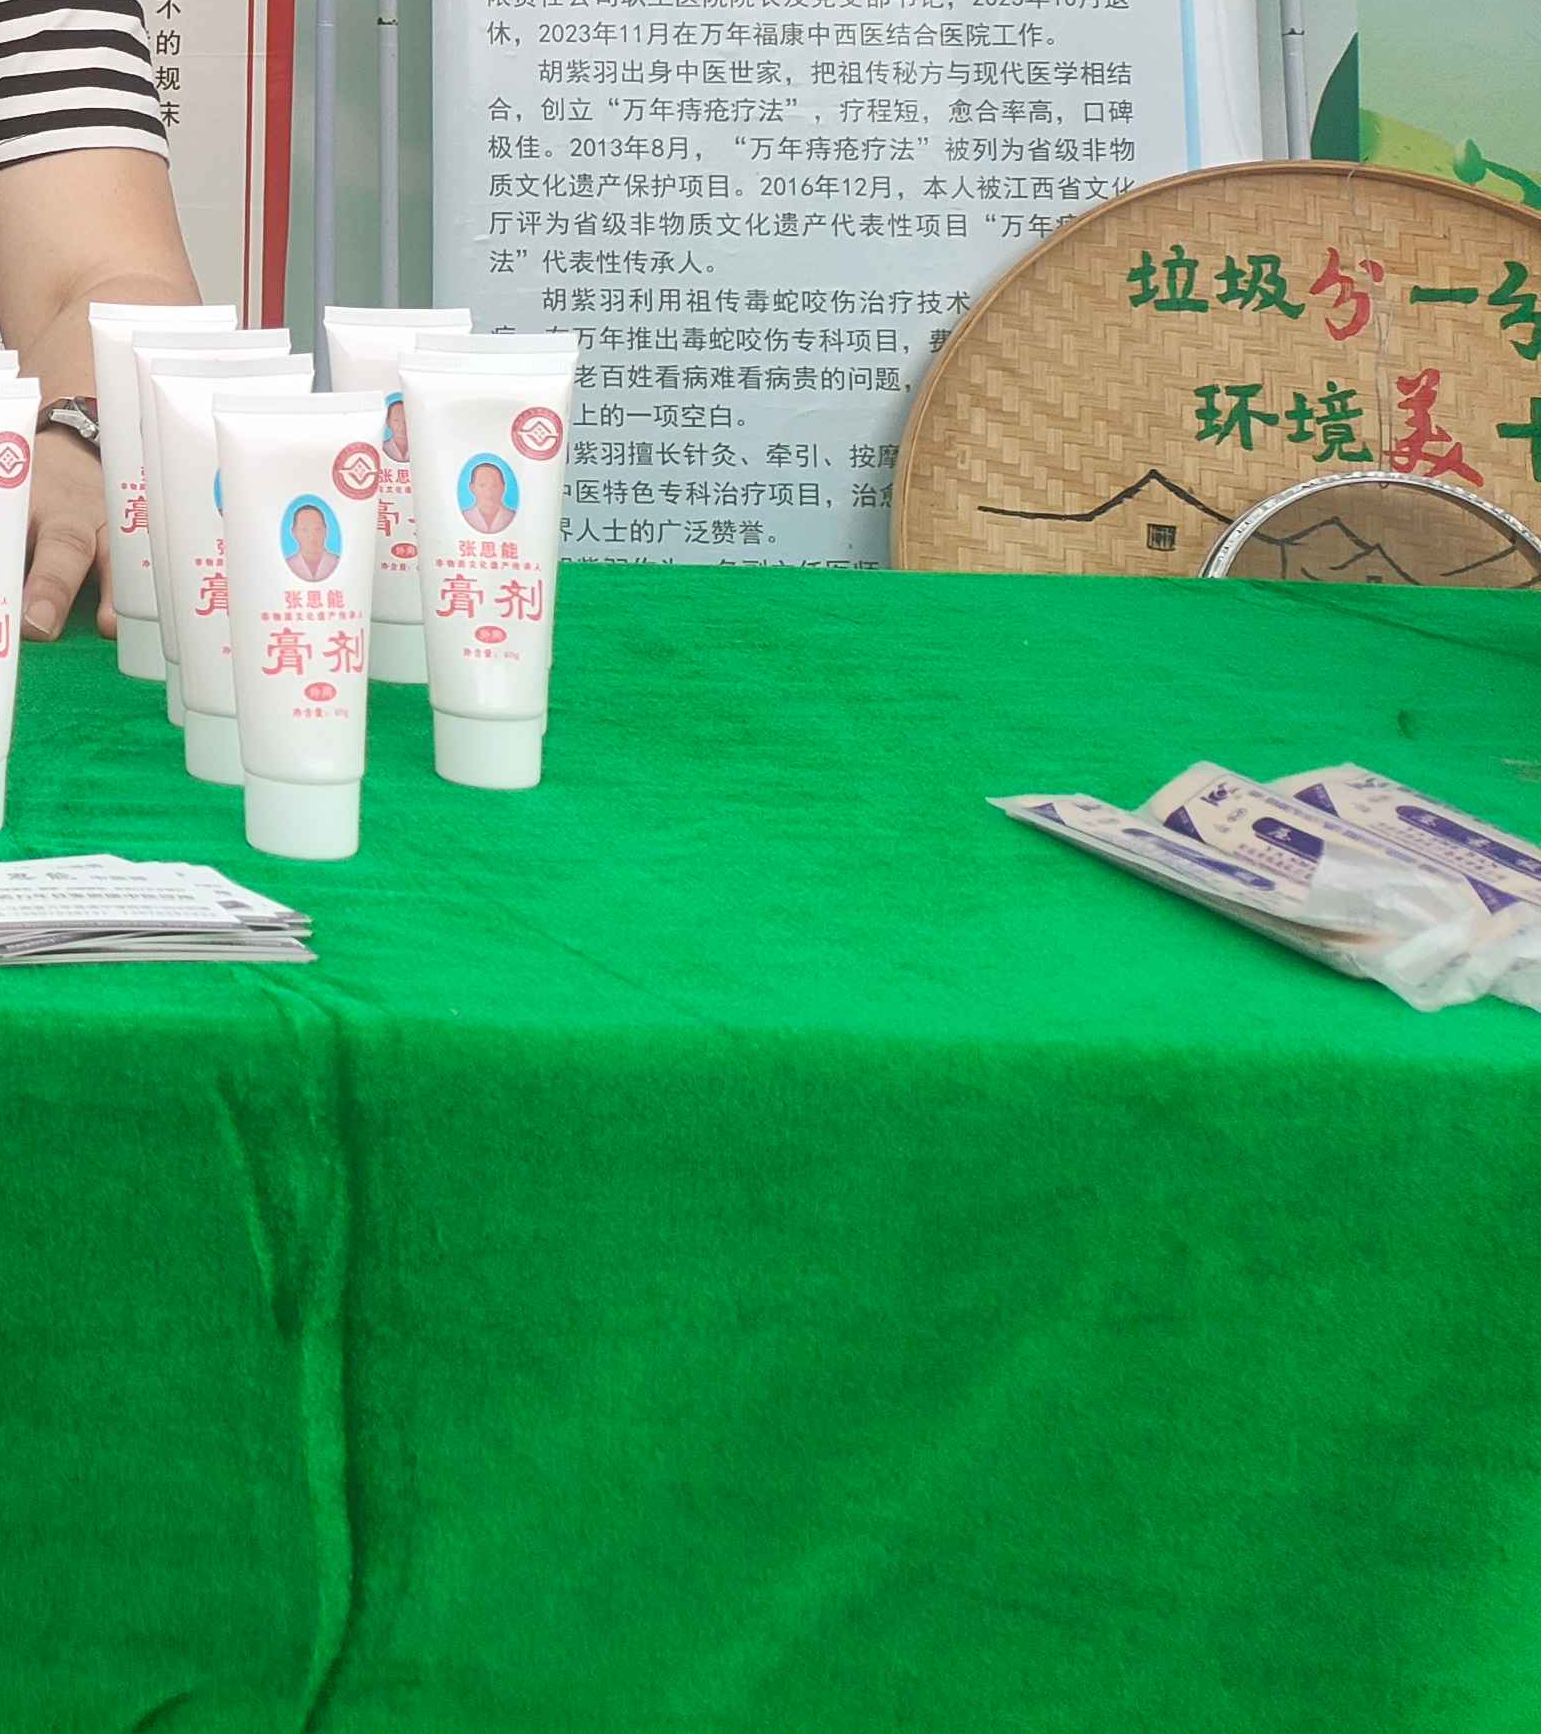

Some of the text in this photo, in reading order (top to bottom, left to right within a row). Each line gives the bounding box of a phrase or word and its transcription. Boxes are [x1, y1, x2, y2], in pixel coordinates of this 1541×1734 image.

[486, 20, 1060, 48] 休，2023年11月在万年福康中西医结合医院工作。
[154, 63, 182, 93] 规
[538, 59, 1132, 86] 胡紫羽出身中医世家，把祖传秘方与现代医学相结
[488, 97, 1135, 125] 合，创立“万年痔疮疗法”，疗程短，愈合率高，口碑
[487, 135, 1136, 163] 极佳。2013年8月，“万年痔疮疗法”被列为省级非物
[488, 173, 1135, 201] 质文化遗产保护项目。2016年12月，本人被江西省文化
[489, 249, 717, 275] 法”代表性传承人。
[542, 287, 970, 315] 胡紫羽利用祖传毒蛇咬伤治疗技术
[573, 364, 914, 393] 老百姓看病难看病贵的问题，
[573, 402, 750, 429] 上的一项空白。
[563, 442, 899, 470] 紫羽擅长针灸、牵引、按摩
[458, 539, 519, 560] 张思能
[284, 589, 346, 609] 张思能
[435, 573, 544, 622] 膏剂
[261, 626, 365, 676] 膏剂
